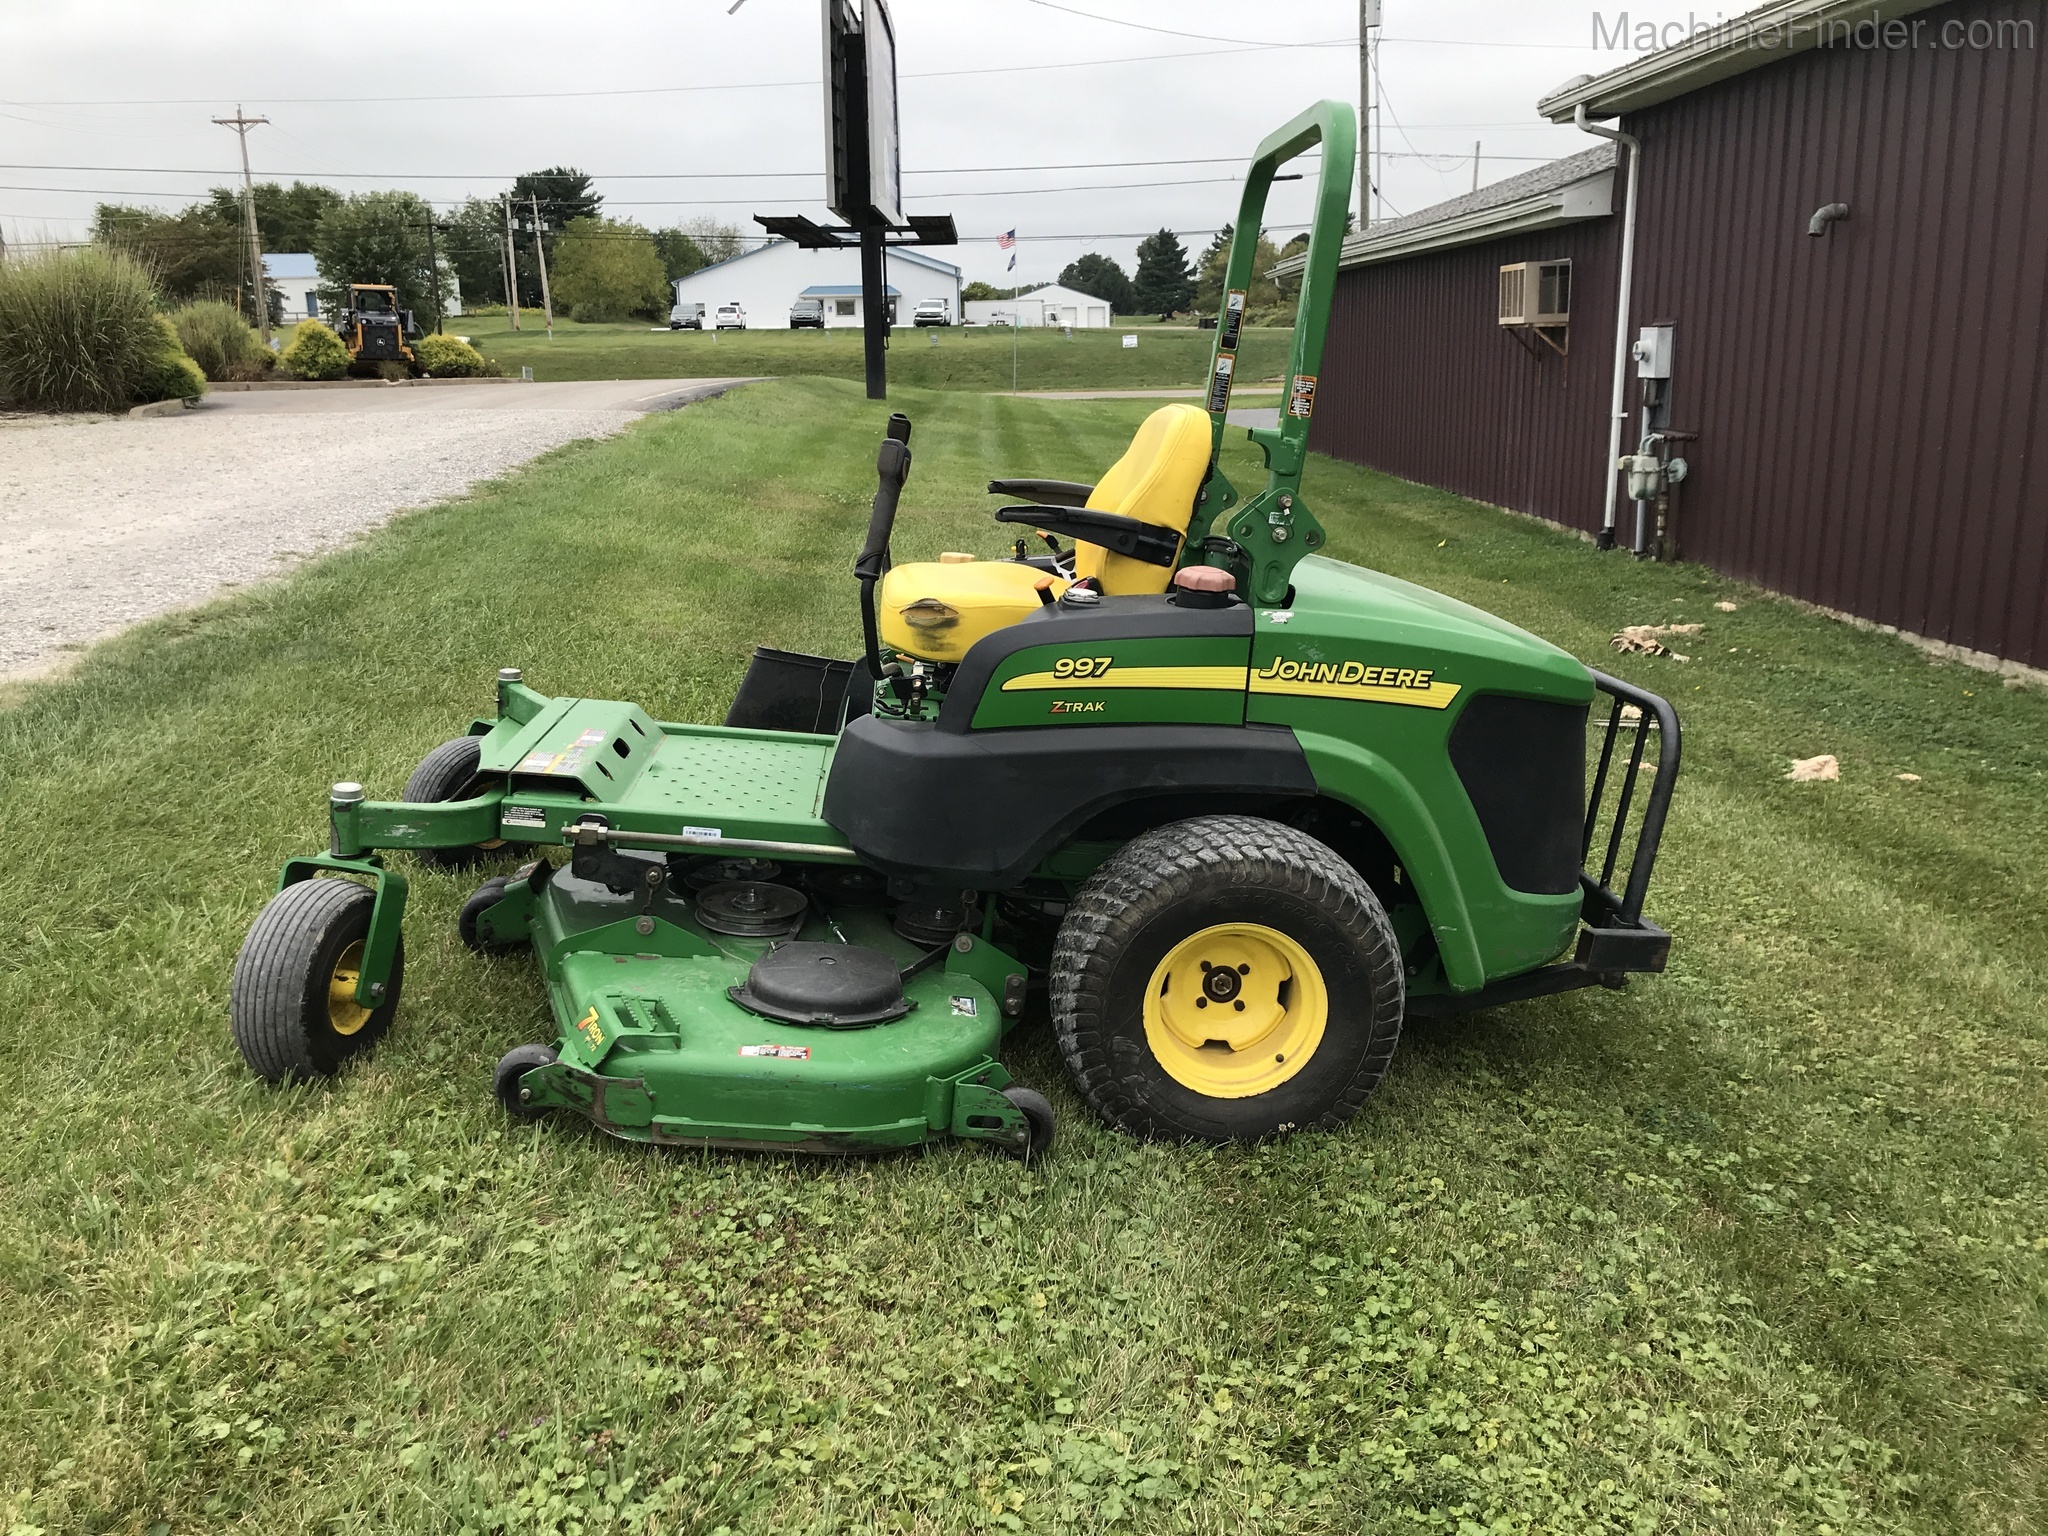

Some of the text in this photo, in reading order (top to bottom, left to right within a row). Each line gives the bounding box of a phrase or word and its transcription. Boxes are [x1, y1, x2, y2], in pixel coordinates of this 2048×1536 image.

[1054, 656, 1114, 679] 997
[1259, 656, 1434, 689] JOHN DEERE
